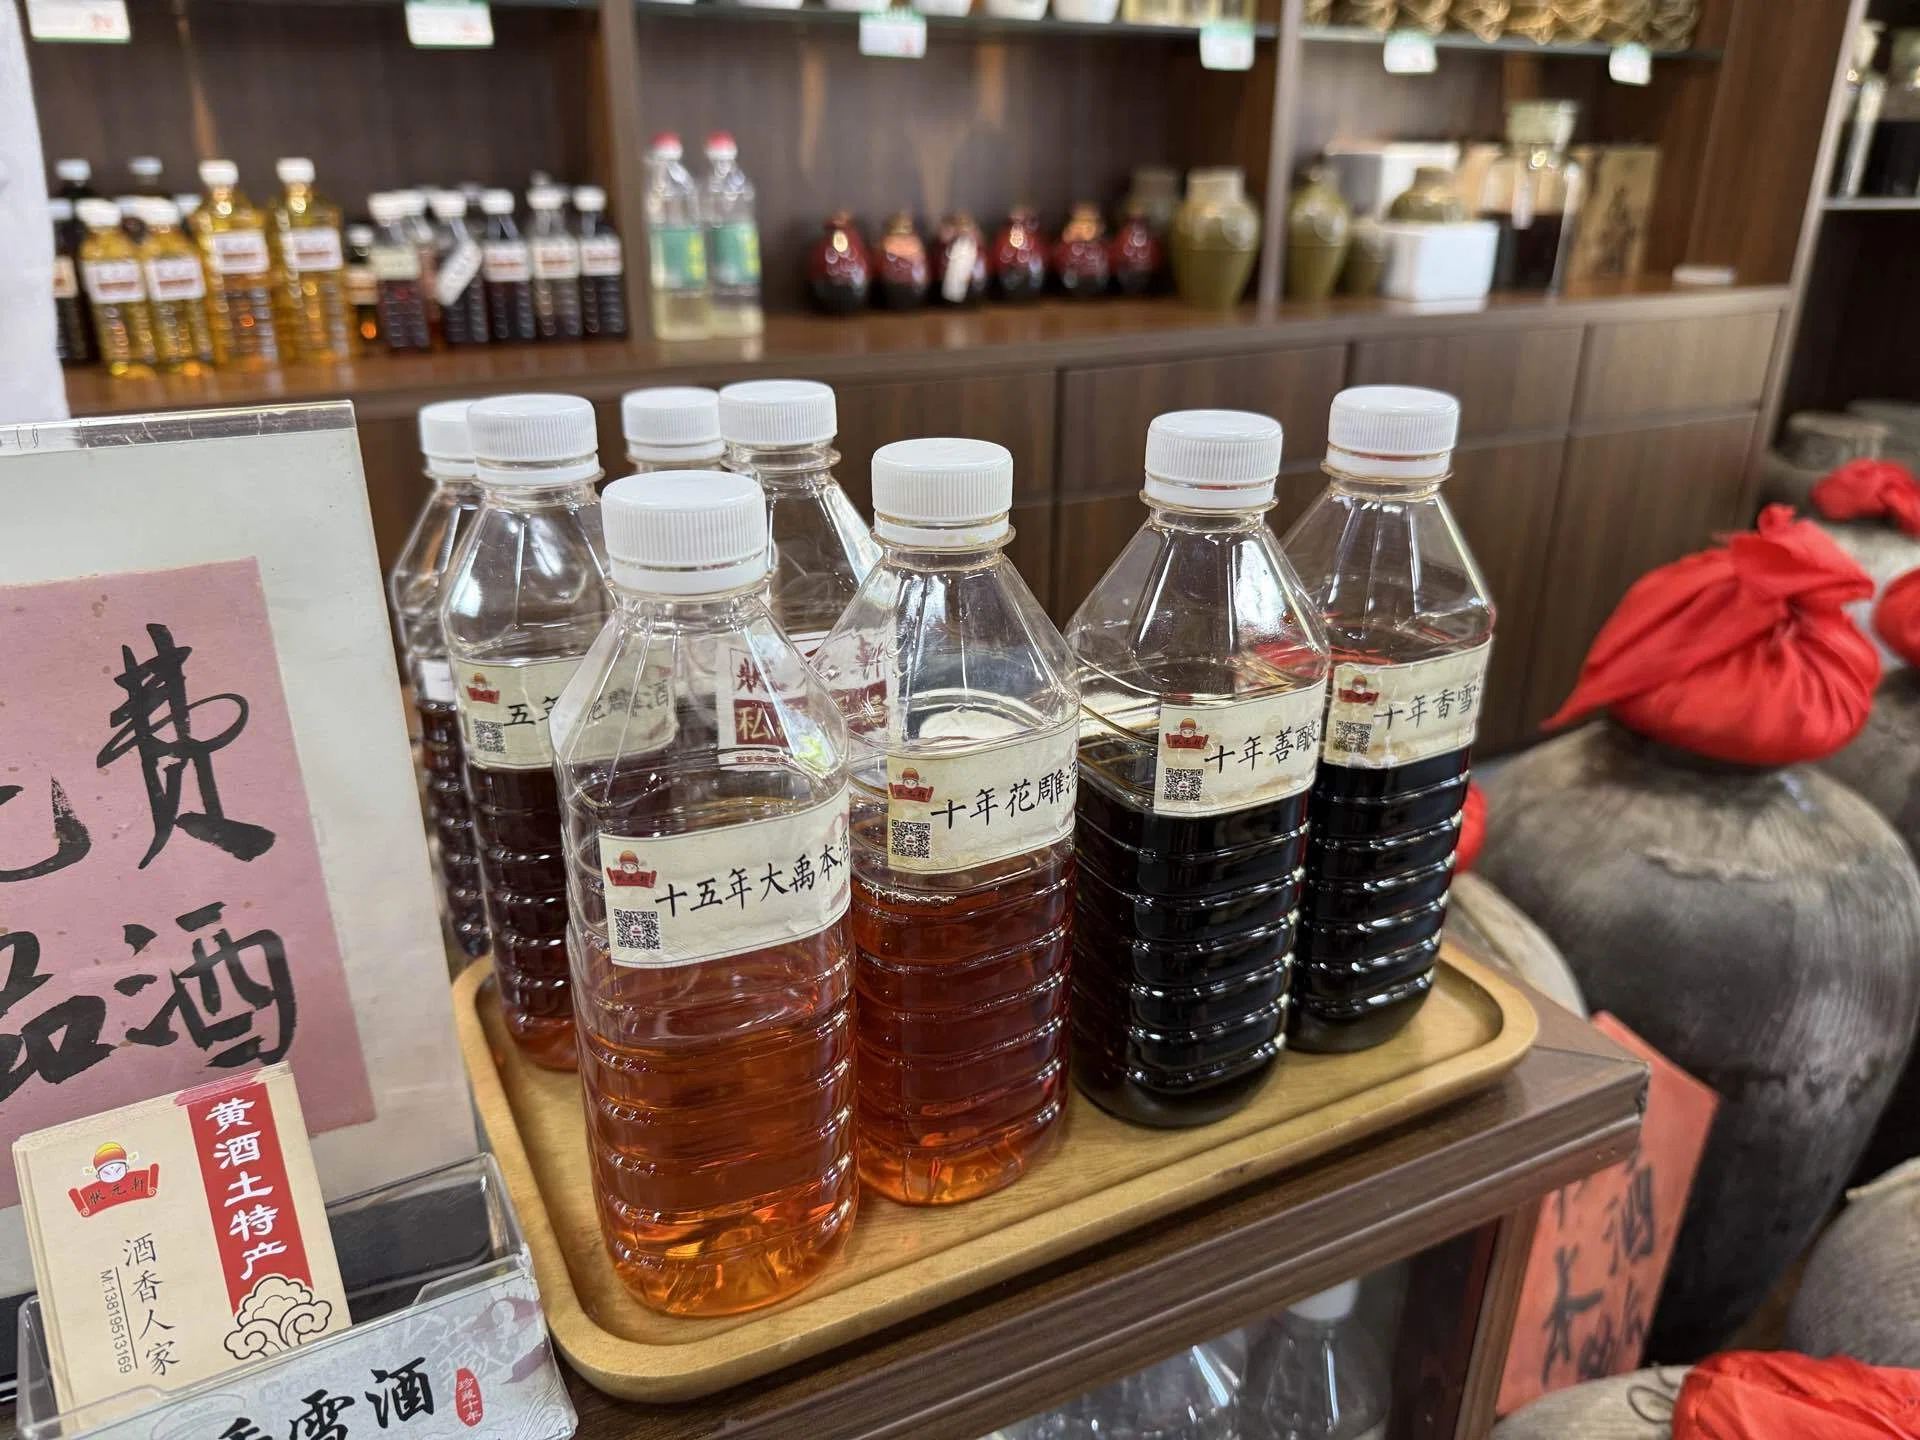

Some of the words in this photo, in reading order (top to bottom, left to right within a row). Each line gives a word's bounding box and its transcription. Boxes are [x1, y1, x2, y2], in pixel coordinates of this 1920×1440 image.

[1204, 719, 1320, 774] 十年善酿
[204, 1096, 288, 1281] 黄酒土特产
[100, 1269, 133, 1375] M:13819513169
[122, 1232, 181, 1376] 酒香人家
